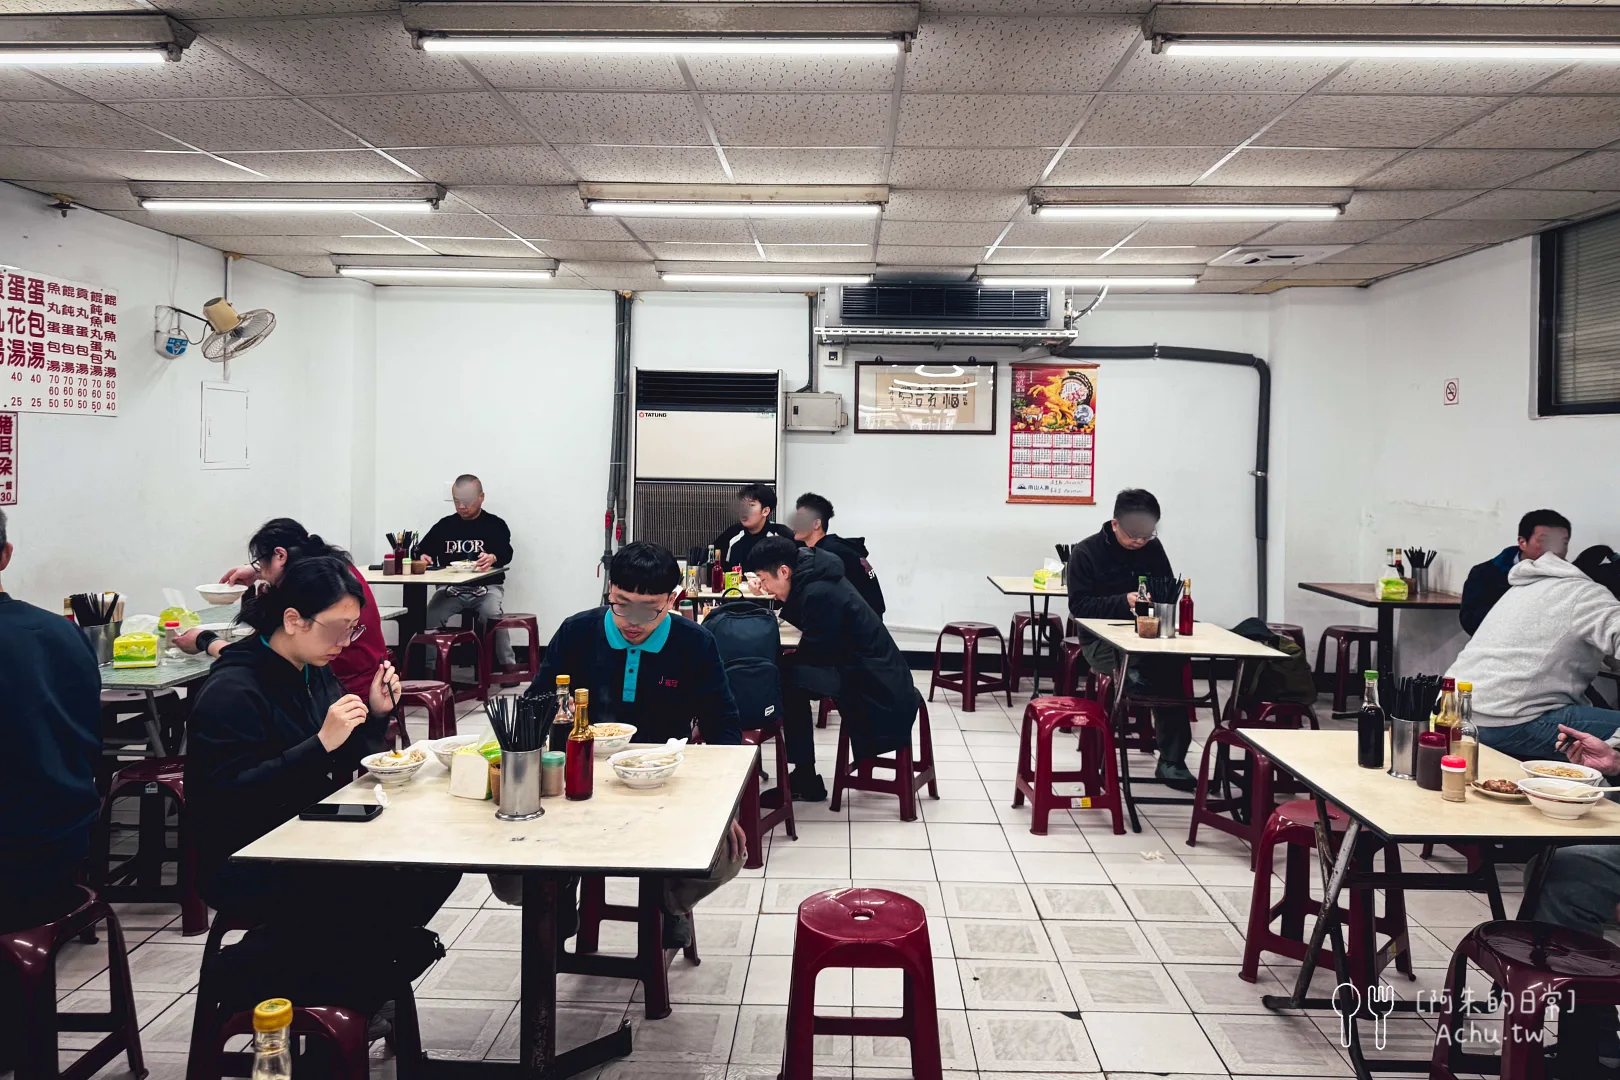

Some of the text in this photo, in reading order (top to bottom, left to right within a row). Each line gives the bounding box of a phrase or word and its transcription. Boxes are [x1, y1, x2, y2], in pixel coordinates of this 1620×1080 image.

[7, 273, 26, 368] 蛋花湯
[27, 277, 46, 369] 蛋包湯
[46, 282, 61, 373] 魚丸蛋包湯
[75, 287, 90, 375] 貢丸蛋包湯
[11, 372, 23, 382] 40
[30, 374, 42, 383] 40
[49, 375, 60, 384] 70
[63, 376, 74, 386] 70
[77, 378, 88, 387] 70
[91, 380, 102, 389] 70
[105, 381, 116, 389] 60
[48, 387, 60, 396] 60
[63, 387, 74, 396] 60
[77, 389, 88, 398] 60
[91, 390, 102, 399] 60
[105, 392, 116, 401] 50
[11, 397, 22, 407] 25
[31, 398, 42, 408] 25
[48, 399, 60, 408] 50
[63, 399, 74, 408] 50
[77, 400, 88, 409] 50
[91, 402, 102, 411] 50
[105, 403, 116, 411] 40
[0, 492, 12, 502] 30
[444, 539, 486, 554] DIOR
